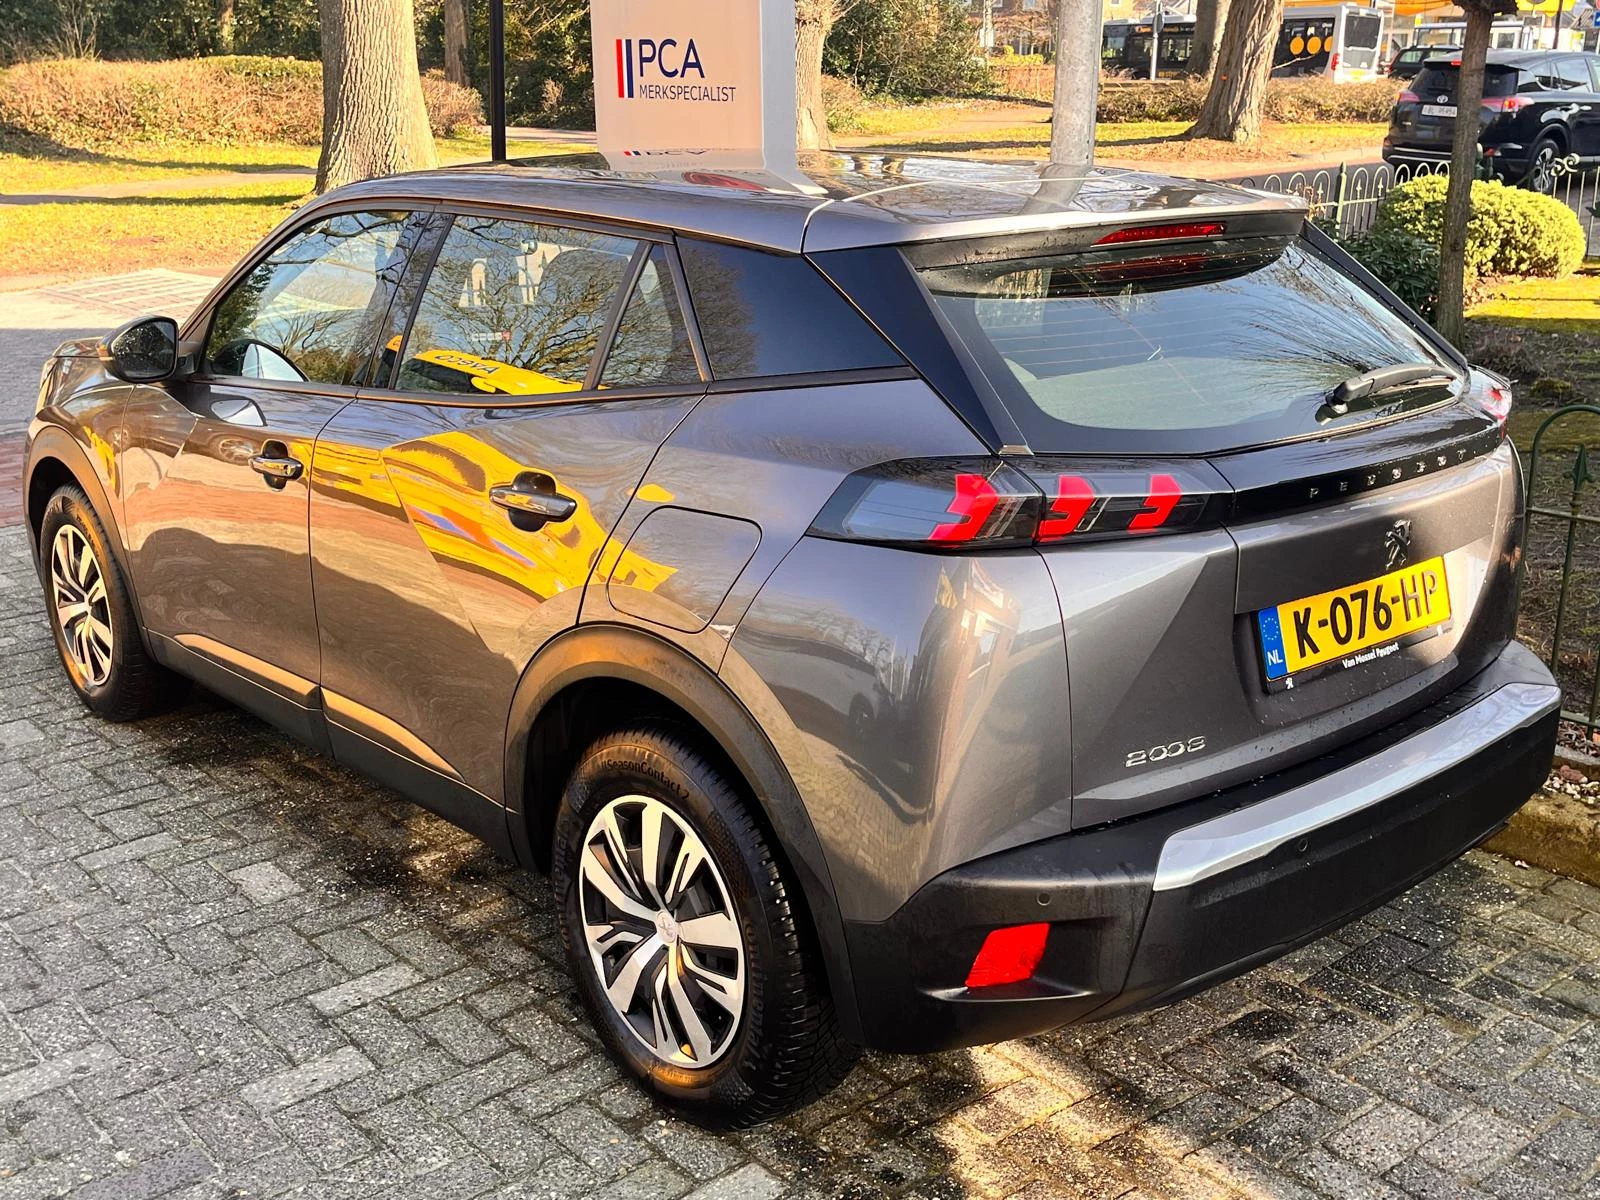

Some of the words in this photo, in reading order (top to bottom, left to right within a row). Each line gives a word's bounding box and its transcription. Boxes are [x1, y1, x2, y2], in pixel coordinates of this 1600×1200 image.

[639, 38, 705, 78] PCA
[639, 84, 737, 102] MERKSPECIALIST
[1309, 449, 1467, 499] PEUGEOT
[1293, 569, 1438, 659] K-076-HP
[1267, 649, 1283, 666] NL
[1342, 658, 1356, 669] Van
[1354, 648, 1377, 665] Mossel
[1125, 735, 1206, 768] 2008
